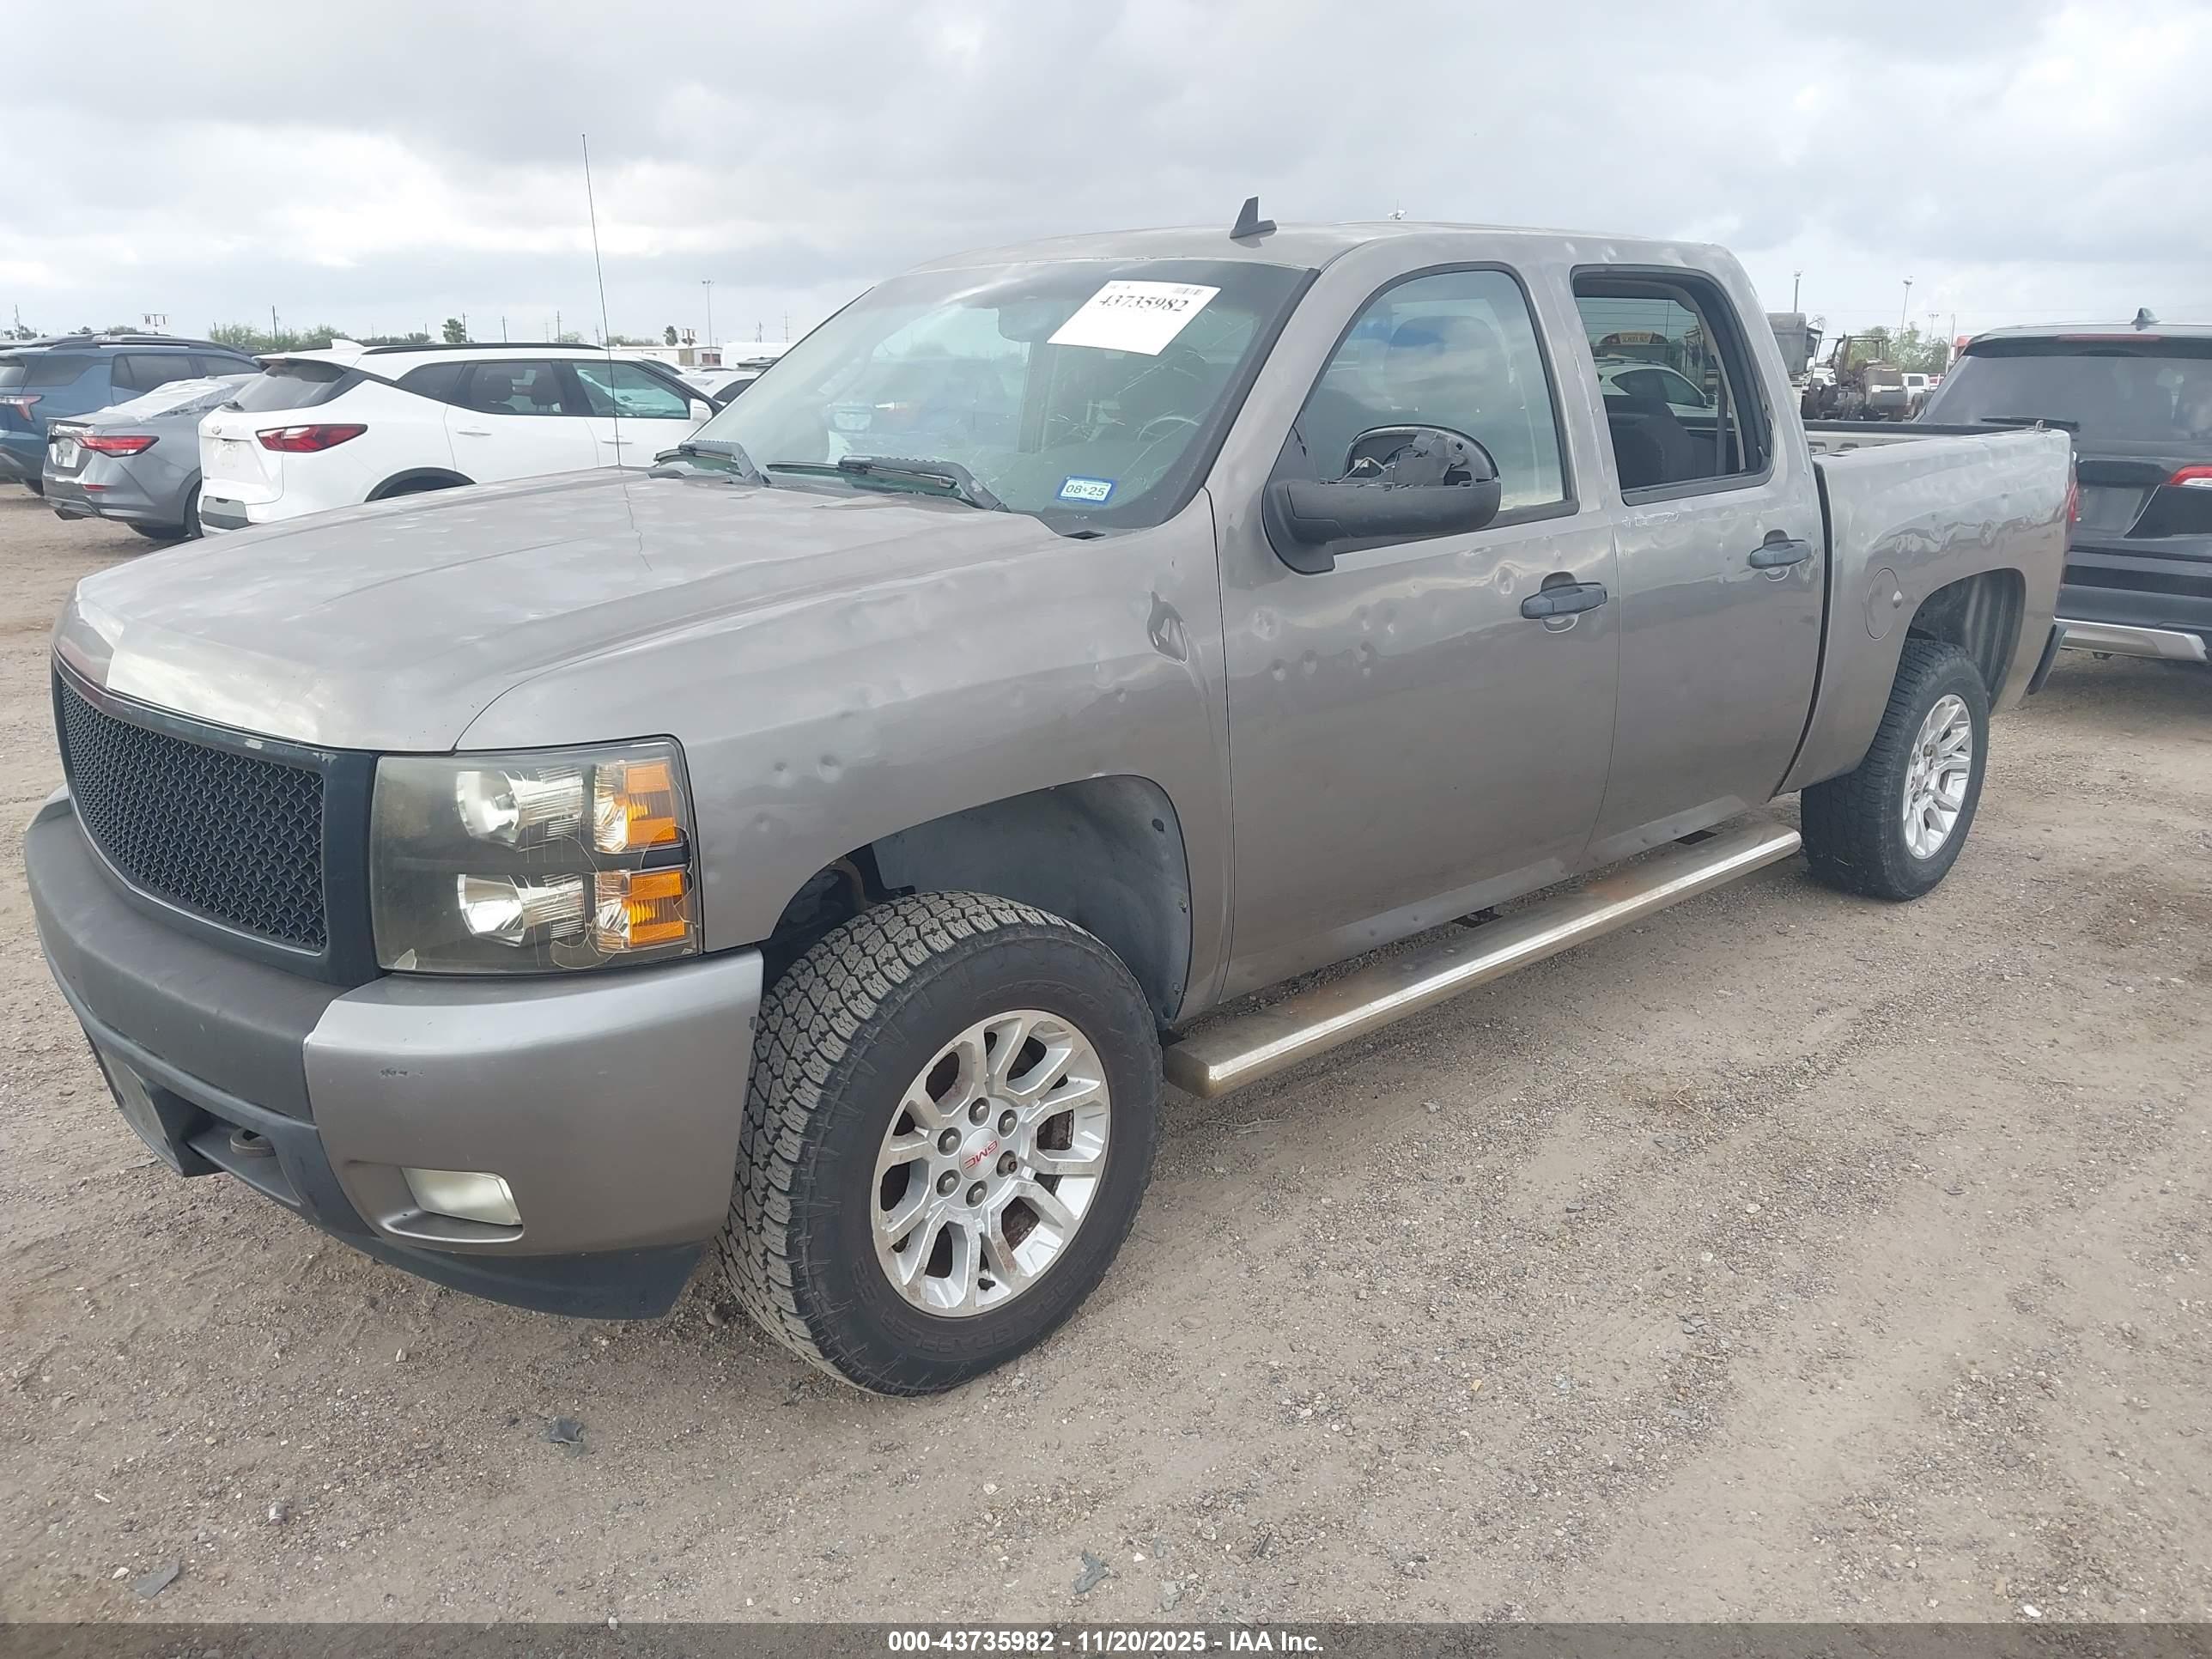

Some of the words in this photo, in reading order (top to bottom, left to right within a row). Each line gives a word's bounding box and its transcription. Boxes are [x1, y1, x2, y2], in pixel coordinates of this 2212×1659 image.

[1099, 294, 1189, 313] 43735982
[1066, 484, 1083, 494] 08
[1087, 486, 1106, 496] 25
[962, 1139, 998, 1170] GMC
